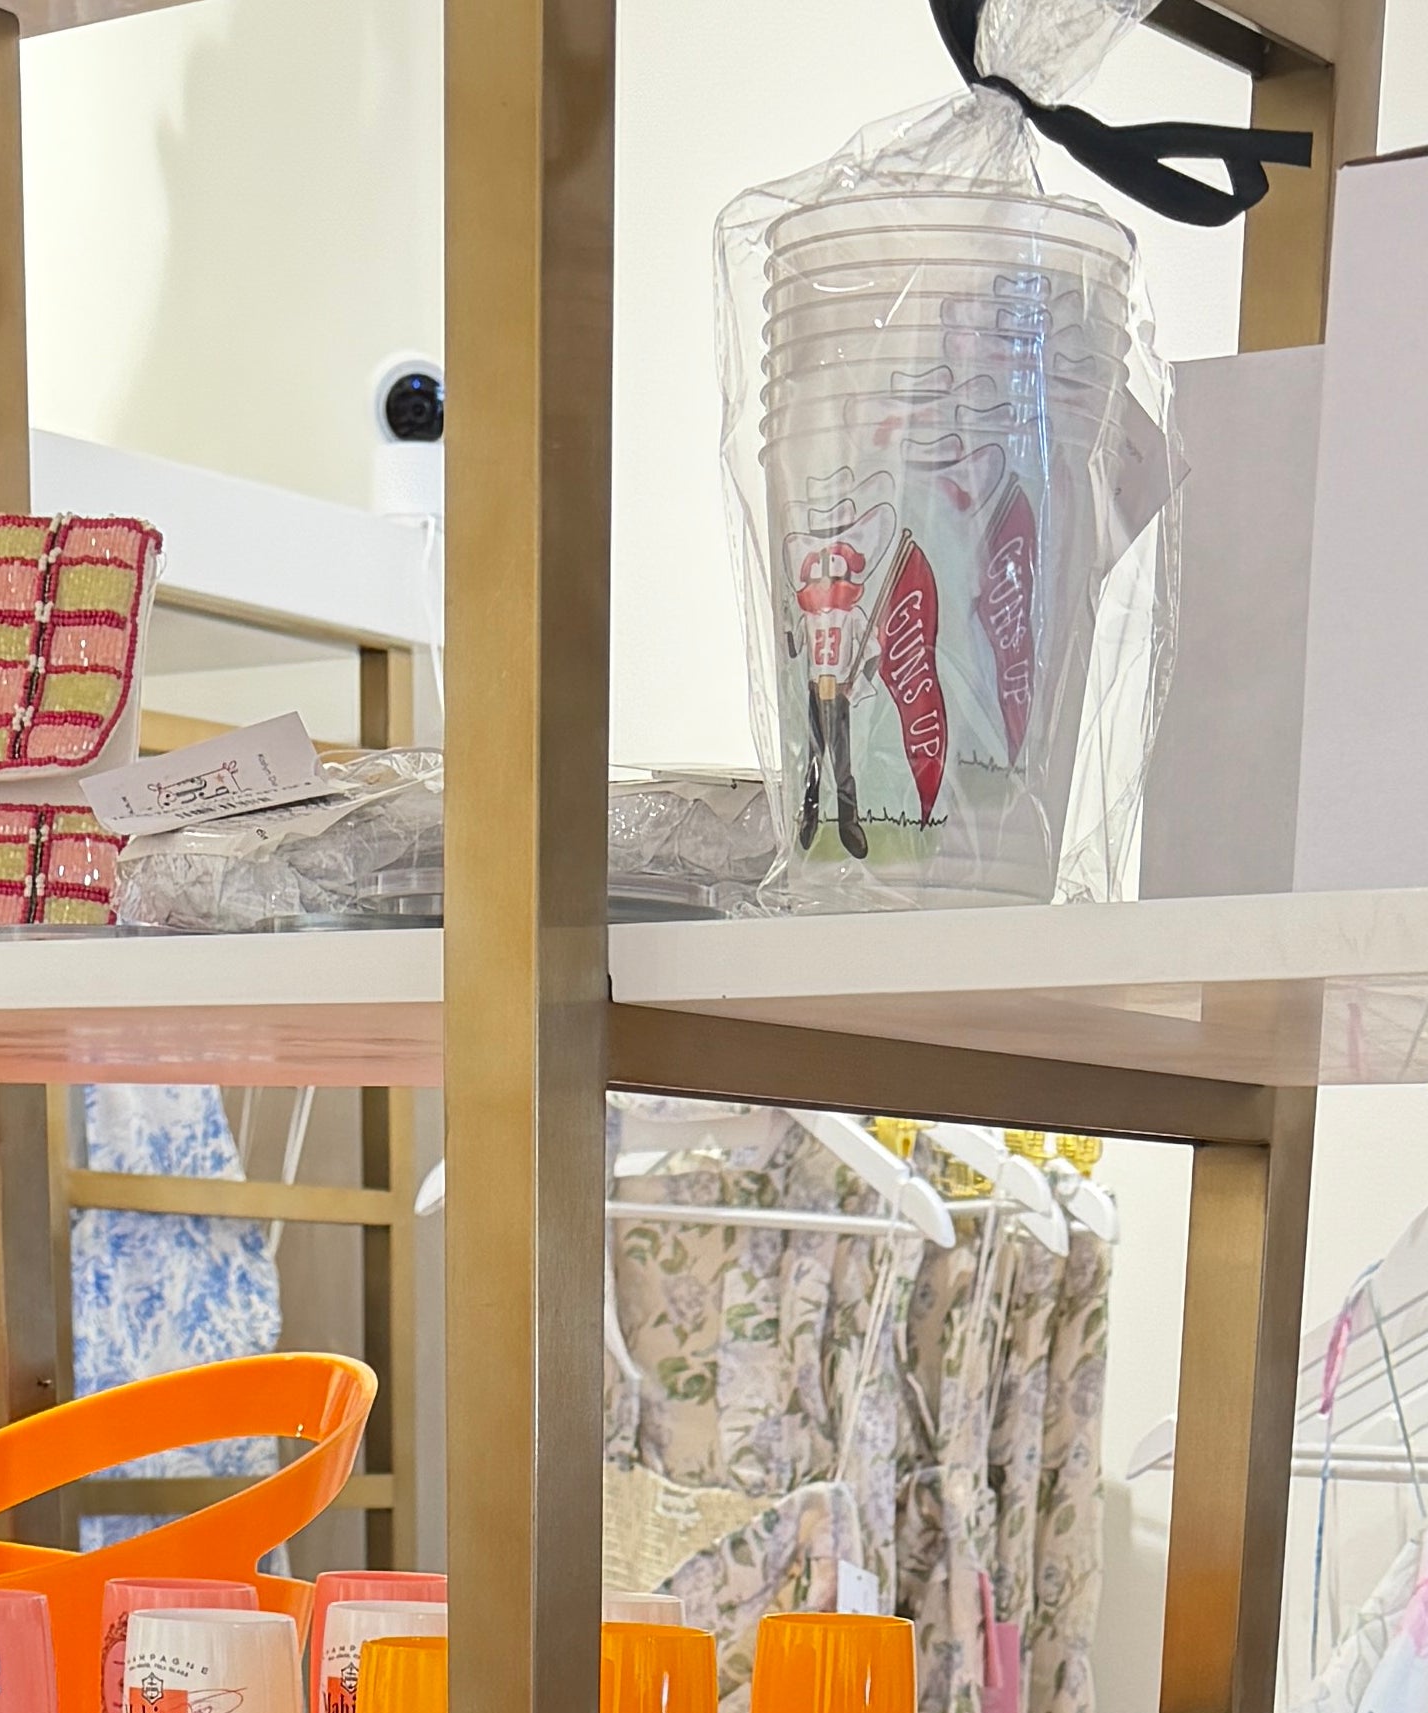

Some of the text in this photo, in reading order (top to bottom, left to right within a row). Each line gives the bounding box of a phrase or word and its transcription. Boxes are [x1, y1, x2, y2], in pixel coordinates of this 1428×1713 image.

[884, 589, 941, 758] GUNS UP
[986, 535, 1032, 706] GUNS UP
